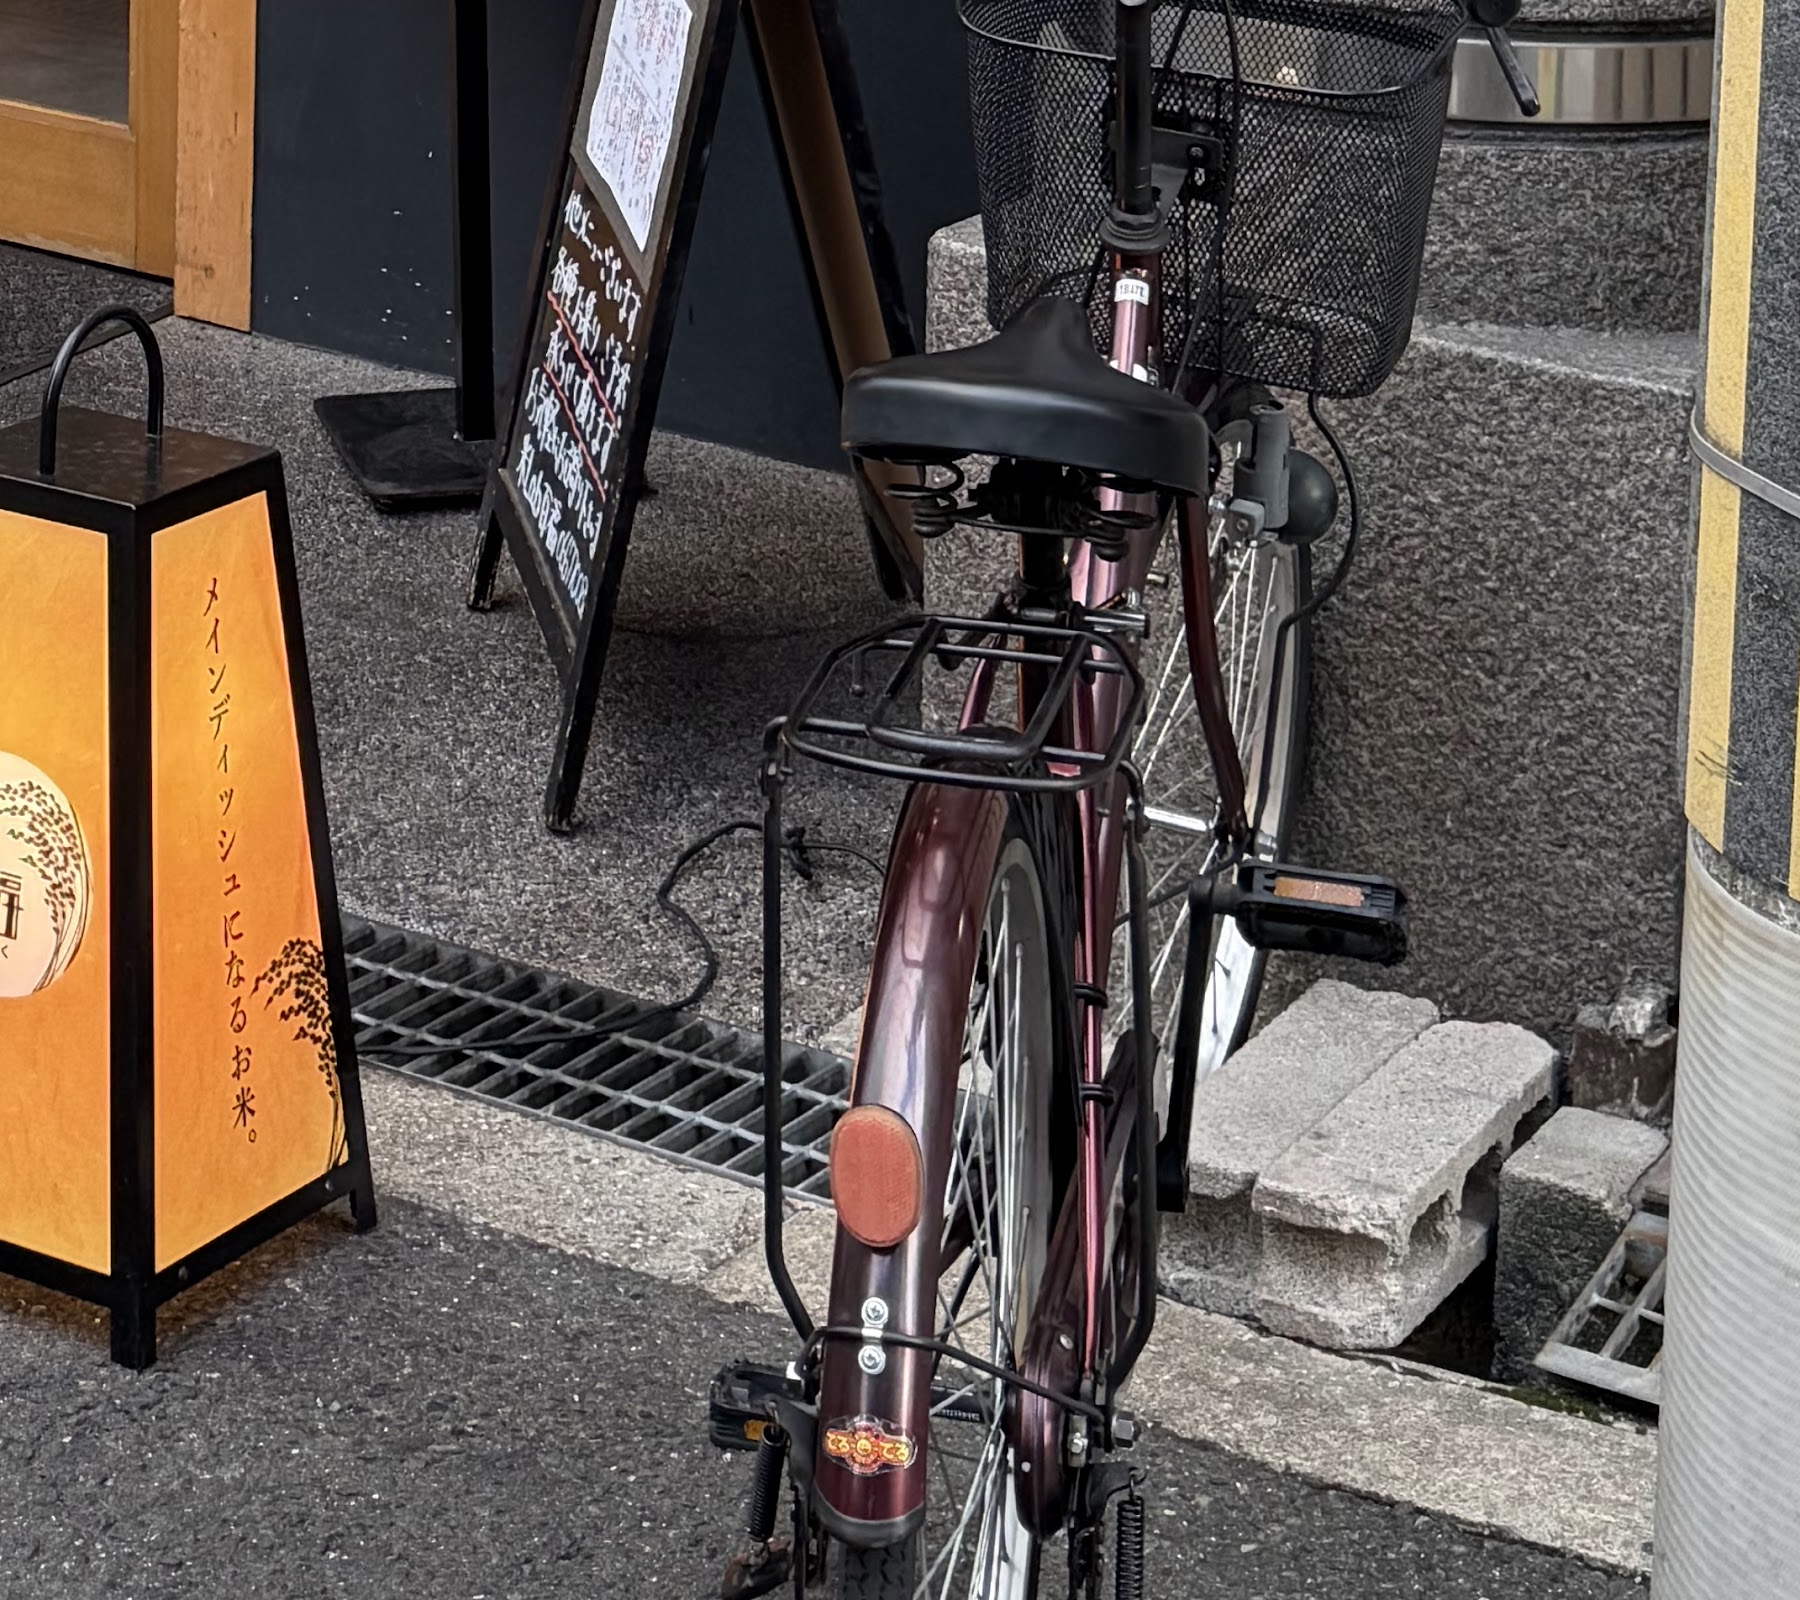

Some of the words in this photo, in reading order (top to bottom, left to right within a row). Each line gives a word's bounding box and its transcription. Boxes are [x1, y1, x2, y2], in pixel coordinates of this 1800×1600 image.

[202, 576, 258, 1144] メインディッシュになるお米。
